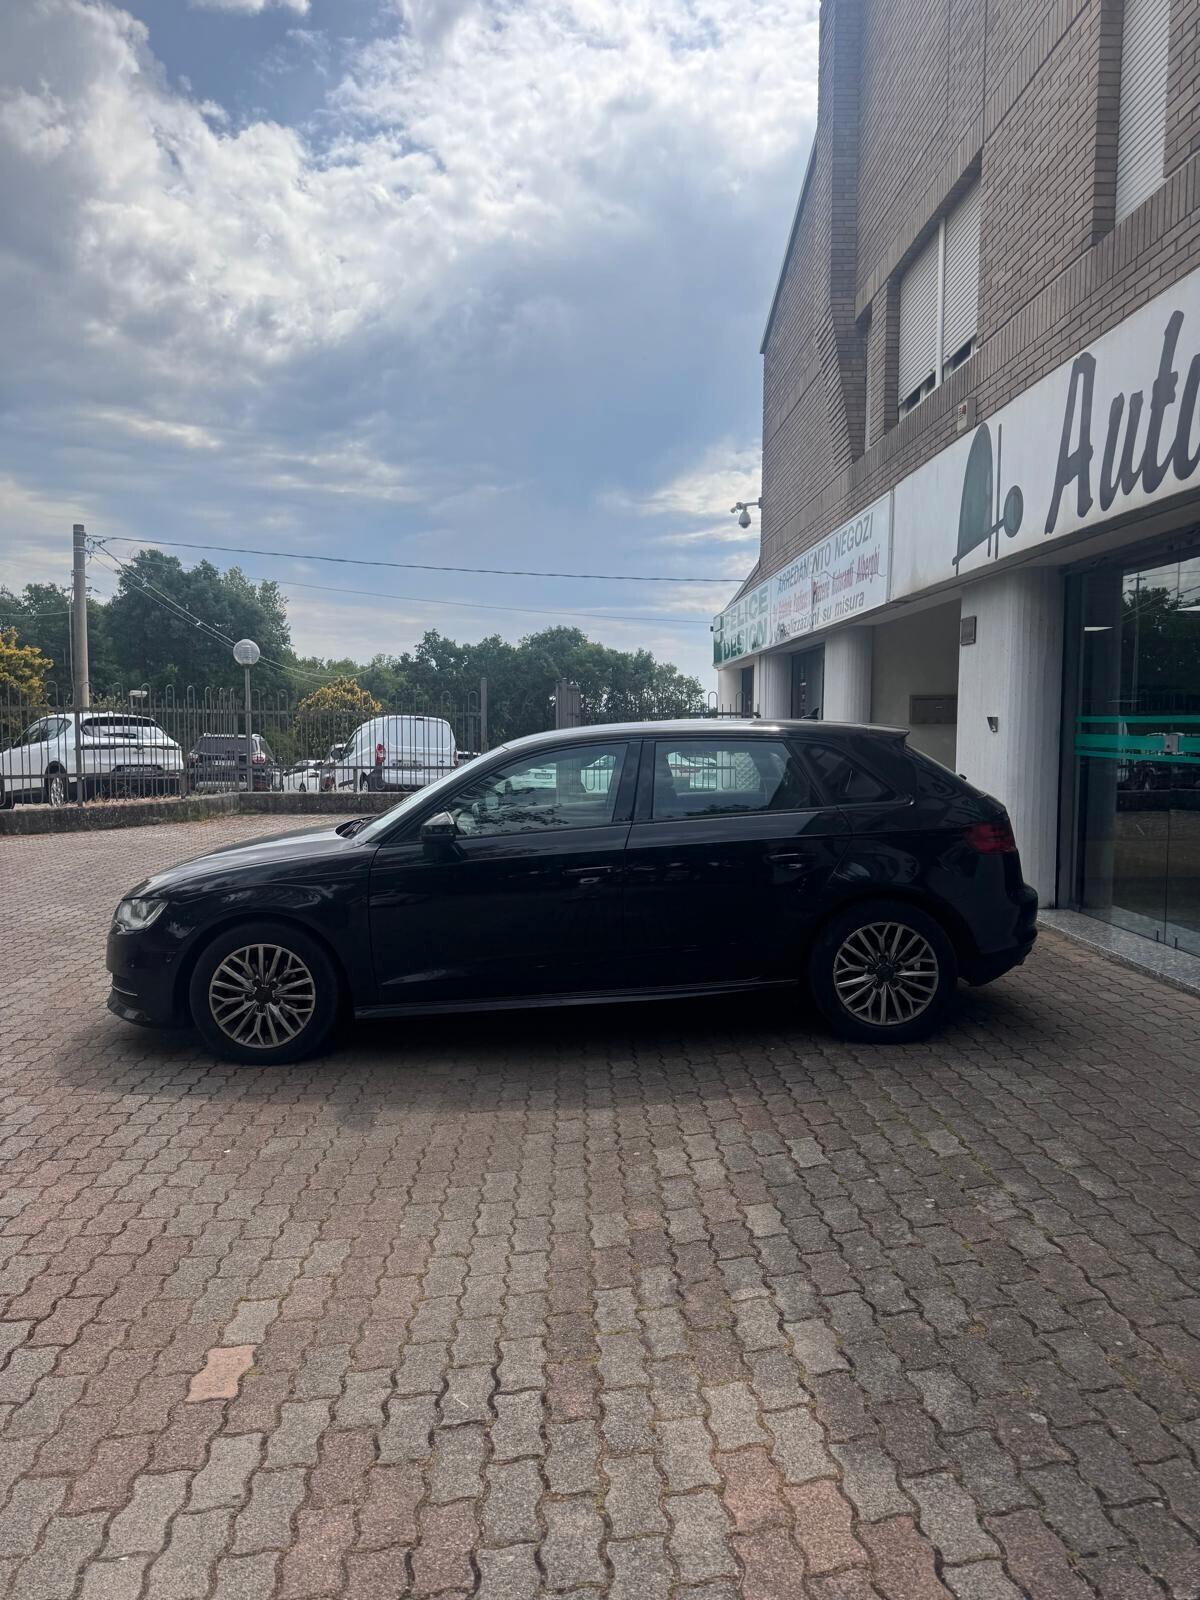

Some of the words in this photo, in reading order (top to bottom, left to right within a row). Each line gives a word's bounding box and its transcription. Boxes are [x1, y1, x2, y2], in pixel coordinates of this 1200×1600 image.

[777, 541, 832, 595] ARREDAMENTO
[834, 511, 873, 561] NEGOZI
[724, 585, 769, 634] FELICE
[822, 605, 832, 622] su
[834, 592, 865, 617] misura
[723, 616, 768, 661] DESIGN
